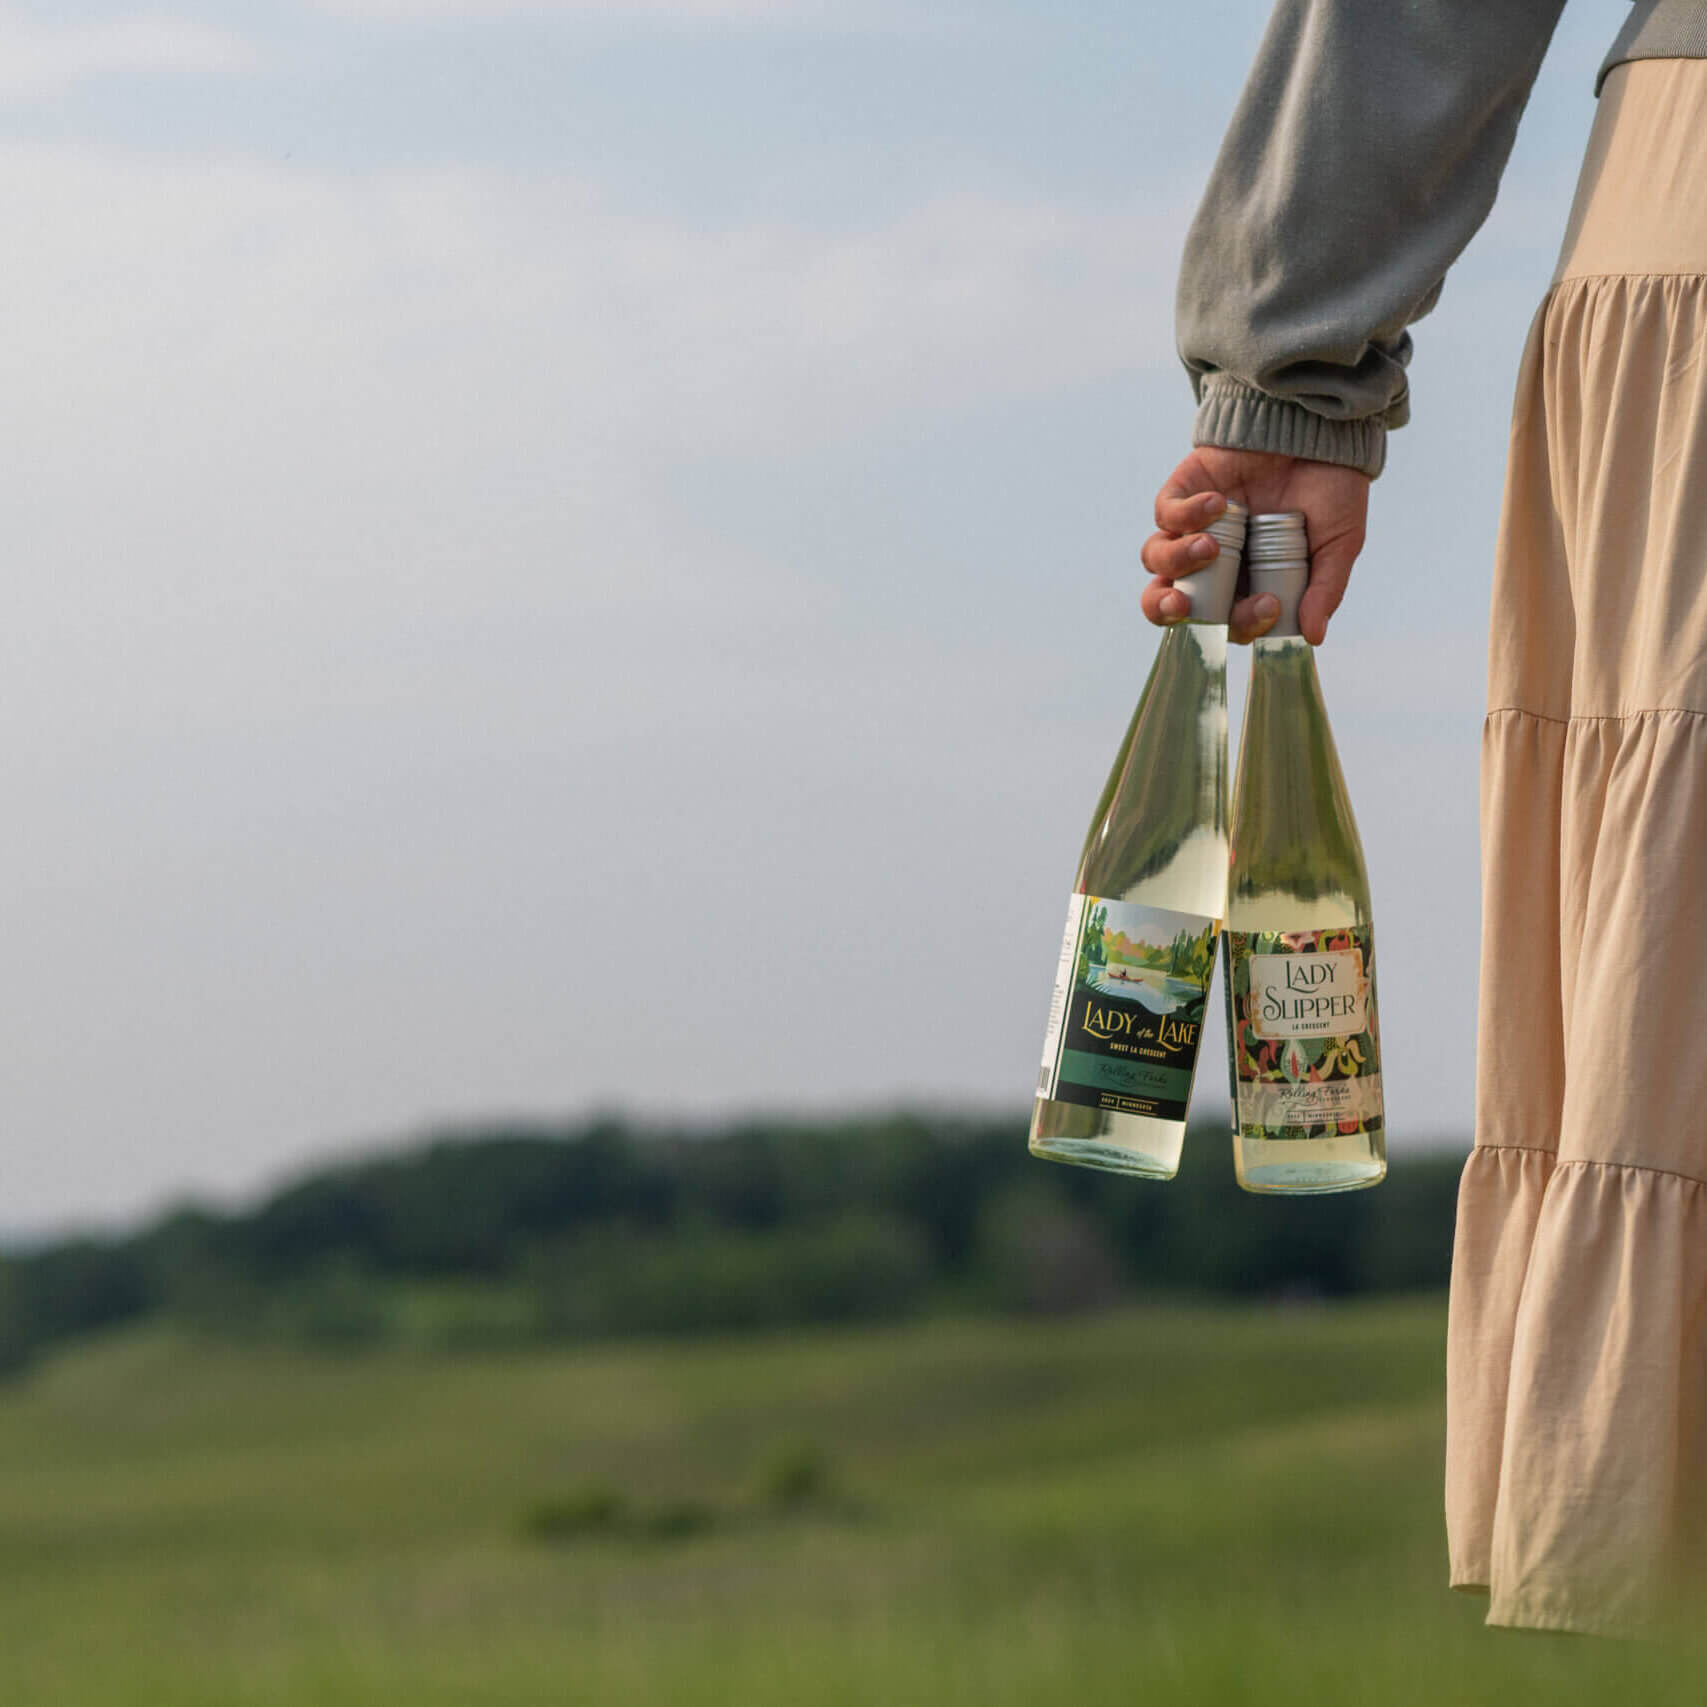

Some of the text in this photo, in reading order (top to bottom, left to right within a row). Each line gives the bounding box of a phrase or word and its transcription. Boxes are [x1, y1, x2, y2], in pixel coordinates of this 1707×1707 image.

[1285, 960, 1338, 994] LADY
[1263, 985, 1356, 1022] SLIPPER
[1081, 1000, 1137, 1039] LADY
[1157, 1015, 1199, 1052] LAKE
[1301, 1022, 1330, 1031] CRESCENT
[1110, 1042, 1167, 1058] SWEET LA CRESCENT
